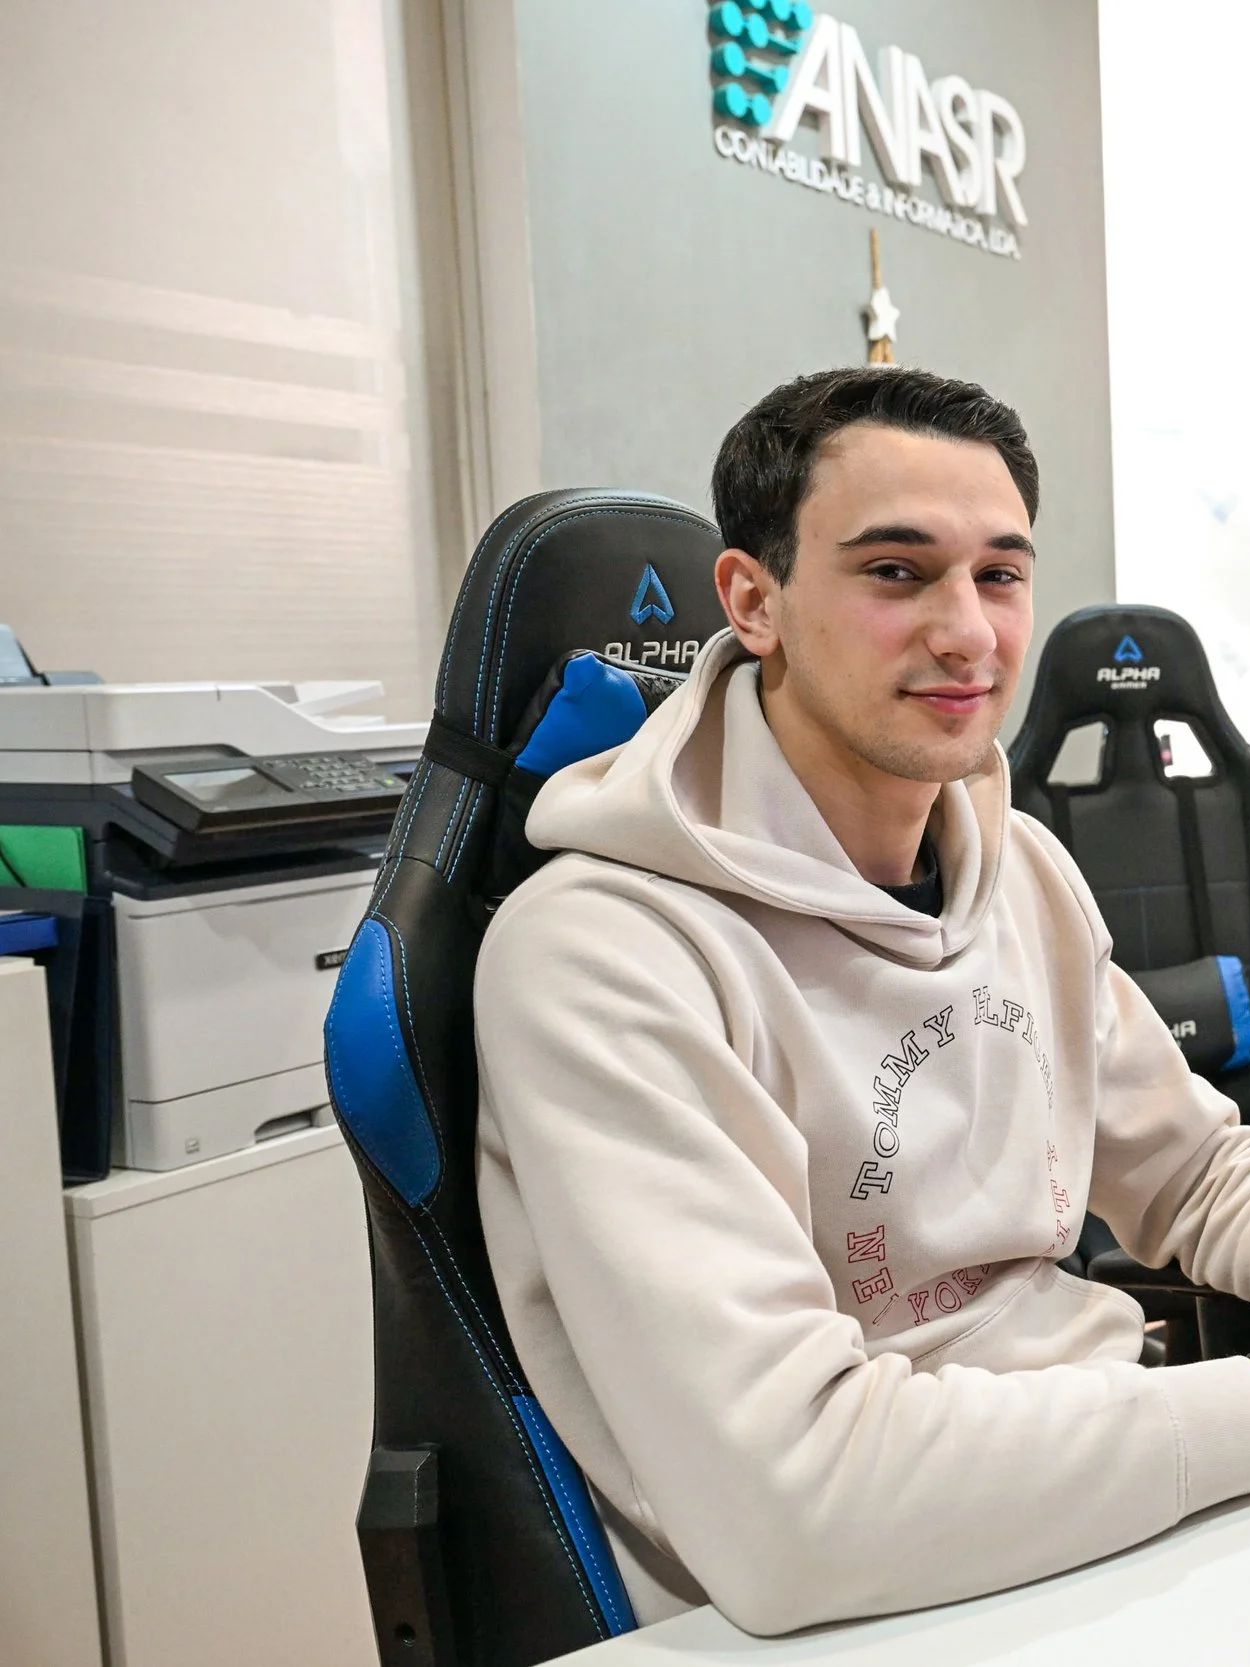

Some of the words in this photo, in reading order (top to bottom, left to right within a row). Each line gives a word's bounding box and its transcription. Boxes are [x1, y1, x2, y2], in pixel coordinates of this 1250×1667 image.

[761, 13, 1028, 226] ANASR
[866, 182, 881, 211] &
[604, 640, 700, 666] ALPHA
[1096, 667, 1161, 682] ALPHA
[850, 1005, 955, 1200] TOMMY
[907, 1263, 990, 1327] YOR
